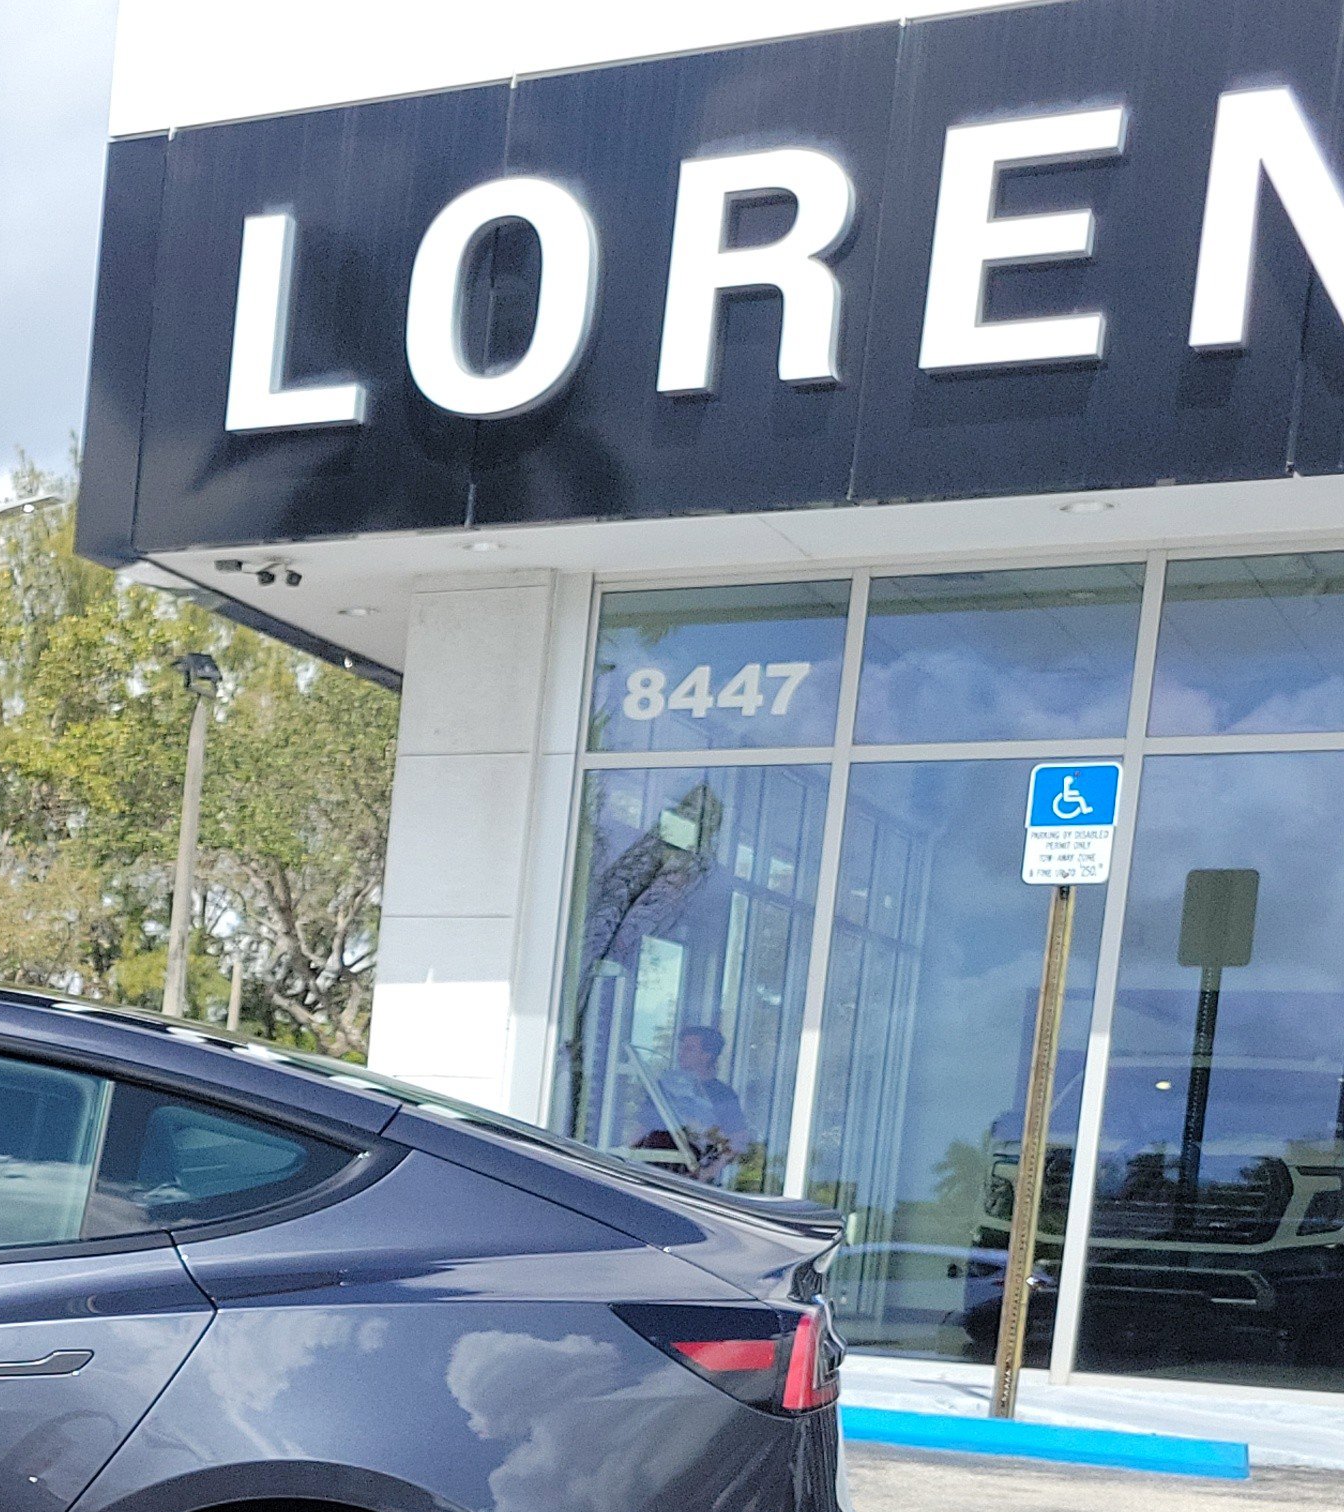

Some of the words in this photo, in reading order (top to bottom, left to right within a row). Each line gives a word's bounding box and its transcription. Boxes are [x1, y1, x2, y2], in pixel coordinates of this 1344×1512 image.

[225, 87, 1344, 432] LOREN
[622, 662, 811, 721] 8447
[1031, 831, 1060, 840] PARKING
[1074, 830, 1110, 840] DISABLED
